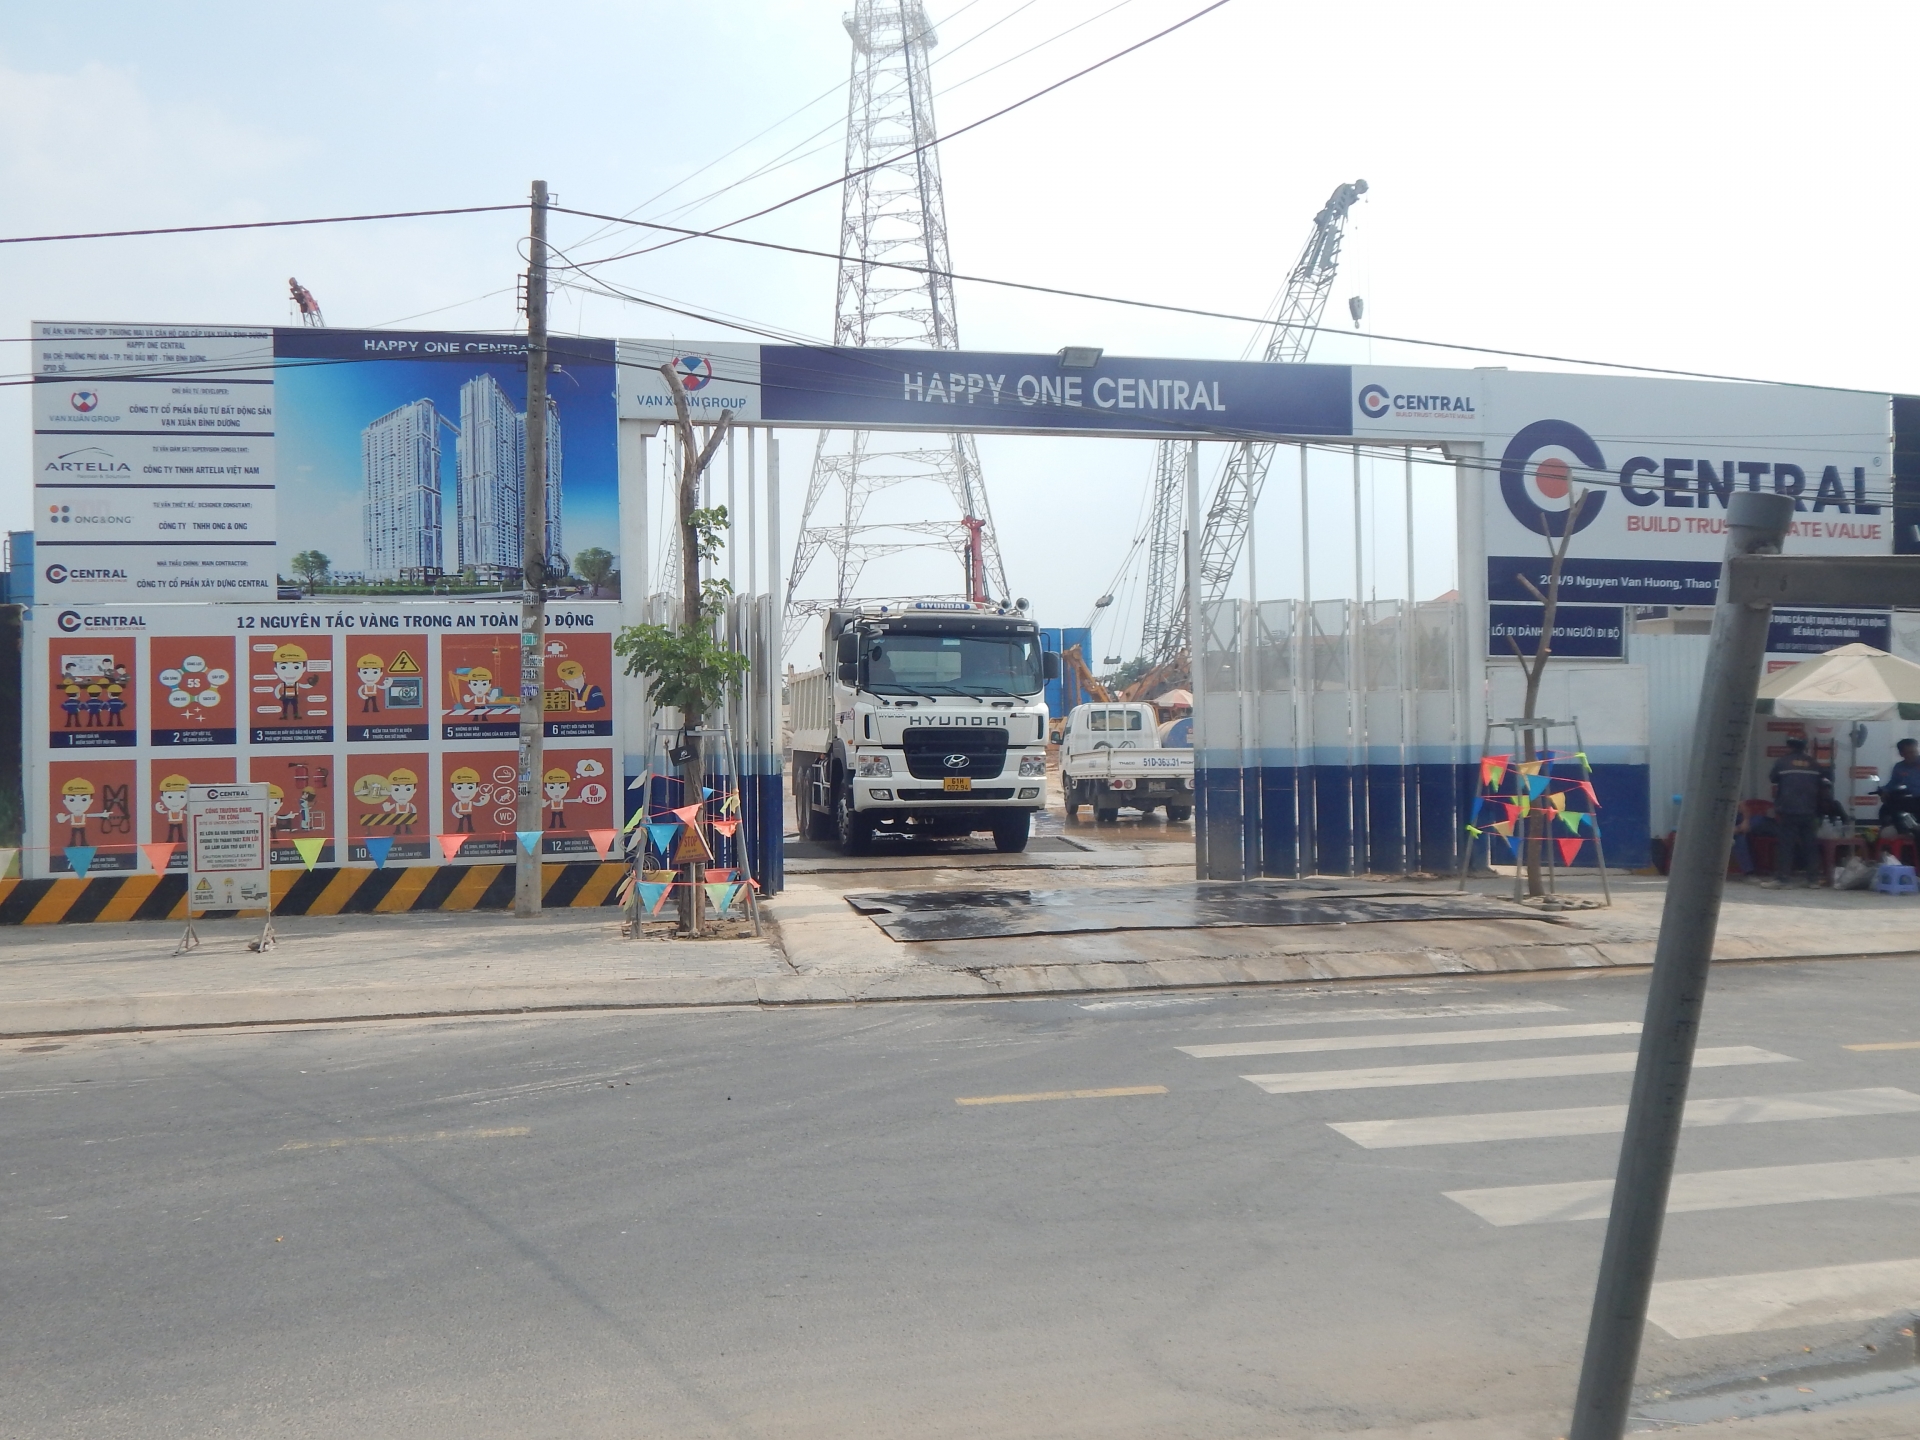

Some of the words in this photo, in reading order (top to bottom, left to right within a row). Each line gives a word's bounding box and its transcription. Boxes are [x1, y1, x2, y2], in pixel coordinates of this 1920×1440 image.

[365, 340, 419, 352] HAPPY
[424, 342, 460, 352] ONE
[465, 343, 529, 355] CENTRA
[902, 372, 1004, 404] HAPPY
[1017, 374, 1082, 407] ONE
[1093, 377, 1226, 412] CENTRAL
[637, 395, 662, 408] VẠN
[666, 394, 700, 407] XÂN
[702, 396, 746, 408] GROUP
[1394, 394, 1476, 412] CENTRAL
[130, 405, 148, 414] CÔNG
[172, 404, 192, 414] PHẦN
[221, 404, 235, 415] BẤT
[258, 406, 272, 415] SẢN
[161, 419, 176, 428] VẠN
[178, 418, 196, 427] XUÂN
[198, 418, 215, 427] BÌNH
[217, 418, 240, 427] DƯƠNG
[44, 462, 132, 472] ARTELIA
[143, 464, 162, 474] CÔNG
[226, 464, 242, 475] VIỆT
[1620, 456, 1882, 516] CENTRAL
[159, 521, 176, 530] CÔNG
[1628, 516, 1681, 533] BUILD
[1825, 522, 1882, 540] VALUE
[70, 569, 128, 578] CENTRAL
[137, 578, 156, 588] CÔNG
[169, 576, 178, 588] CỔ
[180, 577, 199, 588] PHẦN
[201, 578, 215, 588] XÂY
[217, 579, 236, 588] DỰNG
[238, 580, 269, 588] CENTRAL
[1576, 576, 1618, 588] Nguyen
[1620, 577, 1642, 587] Van
[1644, 578, 1682, 590] Huong,
[1685, 578, 1711, 589] Thao
[84, 616, 146, 626] CENTRAL
[237, 616, 255, 629] 12
[260, 612, 321, 628] NGUYÊN
[325, 611, 355, 628] TẮC
[359, 612, 399, 628] VÀNG
[404, 614, 452, 627] TRONG
[456, 614, 476, 627] AN
[480, 611, 518, 627] TOÀN
[555, 611, 594, 628] ĐỘNG
[1492, 623, 1505, 636] LỐI
[1507, 626, 1517, 636] ĐI
[1518, 624, 1543, 637] DÀNH
[1552, 627, 1564, 637] HO
[1566, 624, 1596, 638] NGƯỜI
[1598, 628, 1607, 638] ĐI
[1608, 626, 1620, 639] BỘ
[187, 679, 200, 688] 5S
[910, 716, 1006, 726] HYUNDAI
[363, 729, 369, 739] 4
[447, 727, 453, 737] 5
[552, 725, 558, 734] 6
[68, 732, 73, 745] 1
[173, 732, 180, 742] 2
[256, 730, 263, 741] 3
[499, 812, 512, 821] WC
[552, 840, 562, 851] 12
[684, 836, 697, 847] STOP
[271, 851, 278, 861] 9
[356, 848, 367, 858] 10
